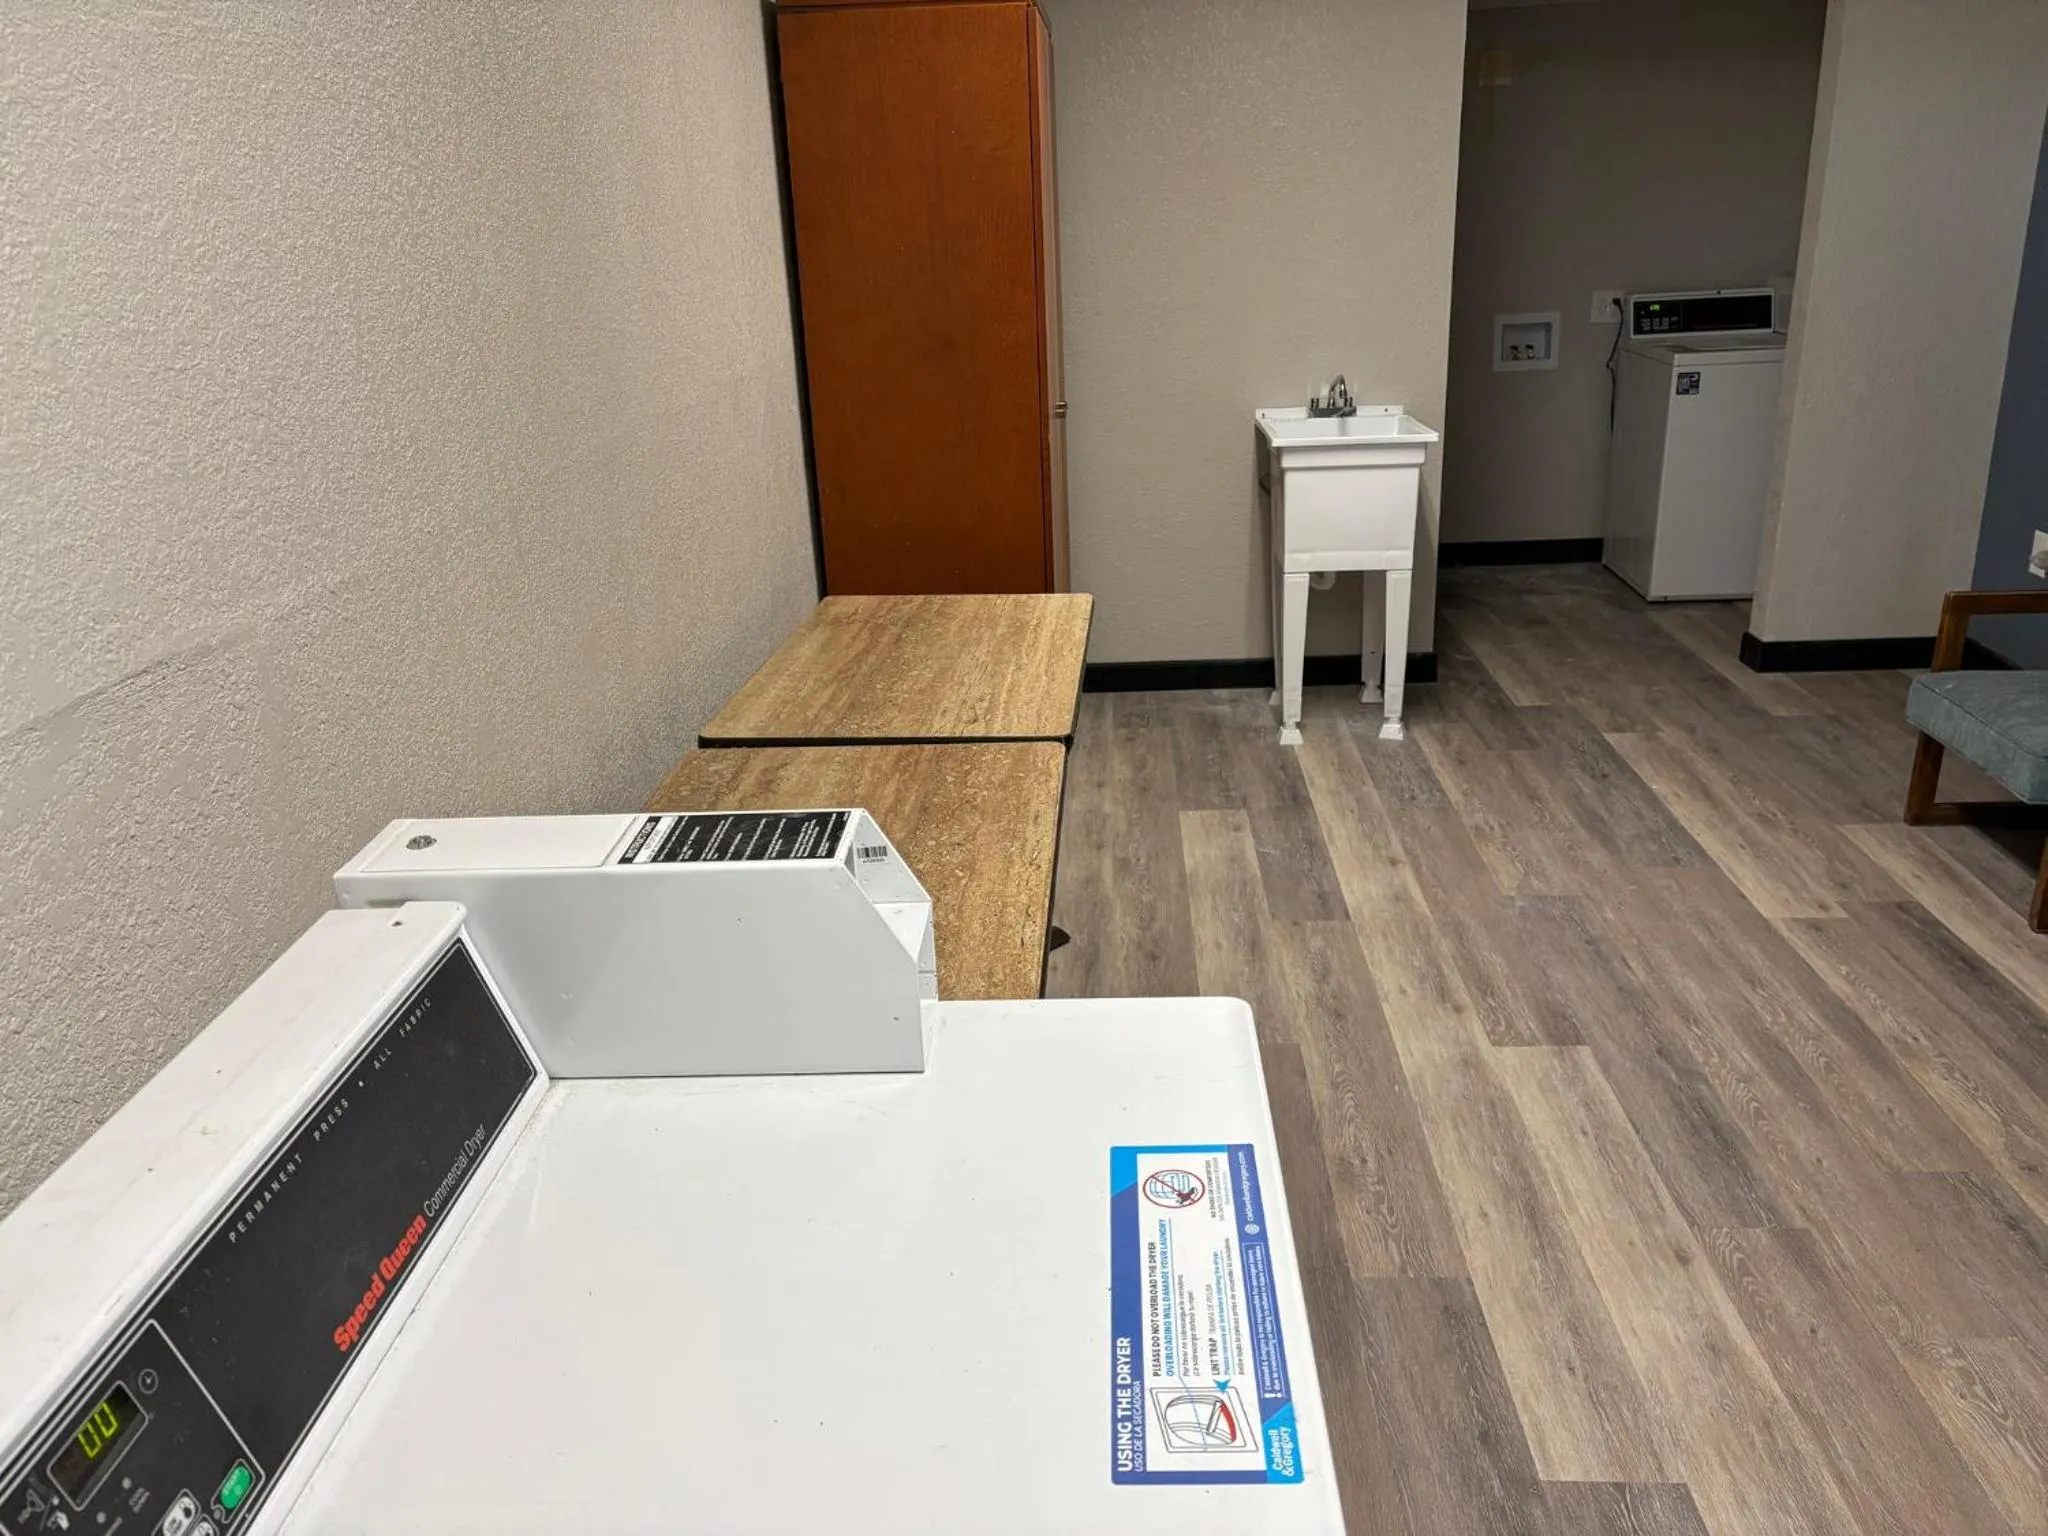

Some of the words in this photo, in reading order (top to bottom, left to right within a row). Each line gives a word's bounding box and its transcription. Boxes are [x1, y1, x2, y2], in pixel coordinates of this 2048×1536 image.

[229, 1153, 302, 1243] PERMANENT
[314, 1099, 349, 1141] PRESS
[374, 1048, 391, 1070] ALL
[400, 998, 431, 1038] FABRIC
[333, 1273, 385, 1352] Speed
[379, 1214, 427, 1281] Queen
[423, 1150, 468, 1217] Commercial
[464, 1124, 486, 1157] Dryer
[1158, 1218, 1167, 1249] LAUNDRY
[1148, 1241, 1156, 1263] DRYER
[1160, 1251, 1168, 1269] YOUR
[1148, 1265, 1157, 1277] THE
[1149, 1278, 1158, 1317] OVERLOAD
[1160, 1271, 1170, 1301] DAMAGE
[1162, 1303, 1171, 1319] WILL
[1150, 1318, 1159, 1334] NOT
[1151, 1335, 1160, 1347] DO
[1163, 1320, 1174, 1376] OVERLOADING
[1208, 1337, 1218, 1357] TRAP
[1116, 1337, 1131, 1383] DRYER
[1152, 1348, 1161, 1376] PLEASE
[1210, 1359, 1220, 1375] LINT
[1117, 1388, 1131, 1417] THE
[1133, 1380, 1142, 1424] SECADORA
[1134, 1426, 1142, 1436] LA
[1134, 1439, 1143, 1450] DE
[1117, 1422, 1132, 1471] USING
[1269, 1430, 1283, 1469] Caldwell
[1134, 1453, 1143, 1471] USO
